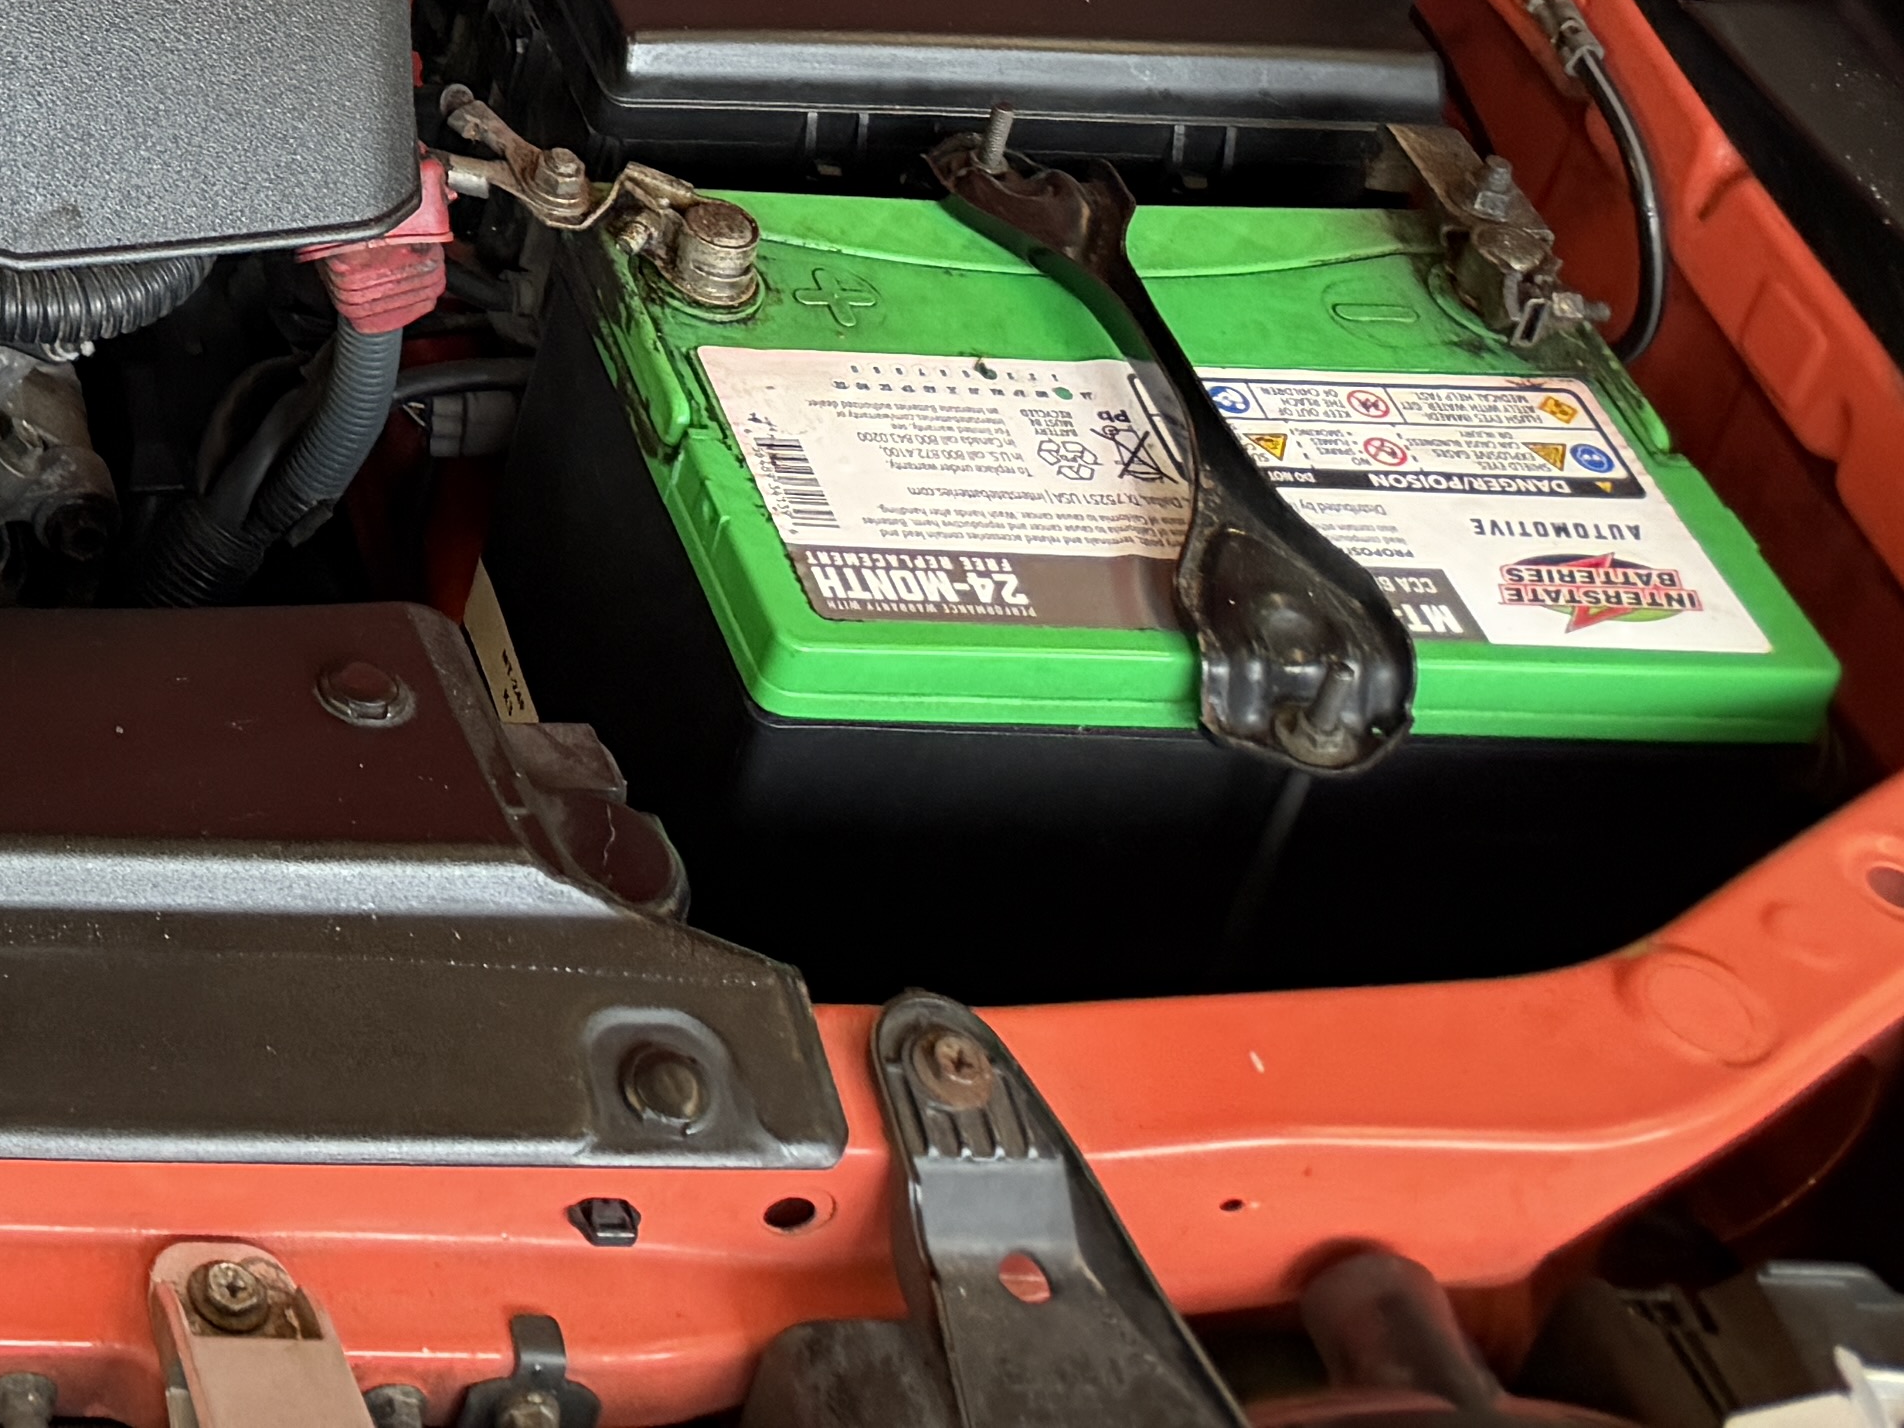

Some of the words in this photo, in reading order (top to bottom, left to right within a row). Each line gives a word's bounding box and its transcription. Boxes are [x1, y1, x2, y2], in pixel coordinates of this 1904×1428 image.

[1323, 389, 1339, 398] OF
[1443, 392, 1472, 403] HELP
[1474, 393, 1529, 404] MEDICAL
[1280, 397, 1321, 408] REACH
[1322, 399, 1346, 409] THE
[1399, 400, 1423, 411] GET
[1468, 402, 1500, 413] WITH
[1020, 409, 1073, 419] RECYCLED
[1278, 407, 1293, 417] OF
[1295, 407, 1320, 418] OUT
[1322, 408, 1352, 418] KEEP
[1501, 403, 1535, 414] ATELY
[1097, 409, 1131, 423] Pb
[1473, 413, 1502, 424] EYES
[1504, 414, 1543, 424] FLUSH
[1044, 419, 1074, 428] MUST
[1034, 427, 1078, 437] BATTERY
[1496, 431, 1513, 440] OR
[939, 435, 959, 446] call
[959, 436, 1003, 447] Canada
[1309, 437, 1351, 447] FLAMES
[1404, 438, 1461, 449] BLINDNESS
[1464, 439, 1497, 450] CAUSE
[1499, 441, 1521, 450] CAN
[965, 450, 985, 461] call
[1316, 446, 1356, 456] SPARKS
[1431, 448, 1470, 460] GASES
[1472, 450, 1536, 462] EXPLOSIVE
[1350, 456, 1372, 466] NO
[1507, 461, 1552, 472] SHIELD
[940, 464, 973, 474] under
[974, 463, 1016, 476] replace
[1017, 466, 1034, 477] To
[1267, 470, 1292, 482] NOT
[1294, 471, 1316, 483] DO
[1367, 472, 1573, 495] DANGER/POISON
[1053, 492, 1083, 505] USA
[1083, 493, 1125, 505] 75251
[1299, 499, 1318, 514] by
[1317, 502, 1387, 516] Distributed
[928, 508, 951, 518] after
[953, 509, 987, 519] hands
[987, 510, 1018, 520] Wash
[861, 517, 907, 528] Batteries
[902, 530, 926, 540] lead
[1468, 518, 1641, 541] AUTOMOTIVE
[926, 531, 965, 540] contain
[805, 550, 954, 570] REPLACEMENT
[958, 556, 1013, 572] FREE
[1503, 567, 1676, 588] BATTERIES
[810, 566, 1029, 605] 24-MONTH
[1394, 576, 1436, 596] CCA
[1503, 586, 1697, 608] INTERSTATE
[826, 599, 862, 610] WITH
[865, 601, 937, 614] WARRANTY
[941, 604, 1037, 617] PERFORMANCE
